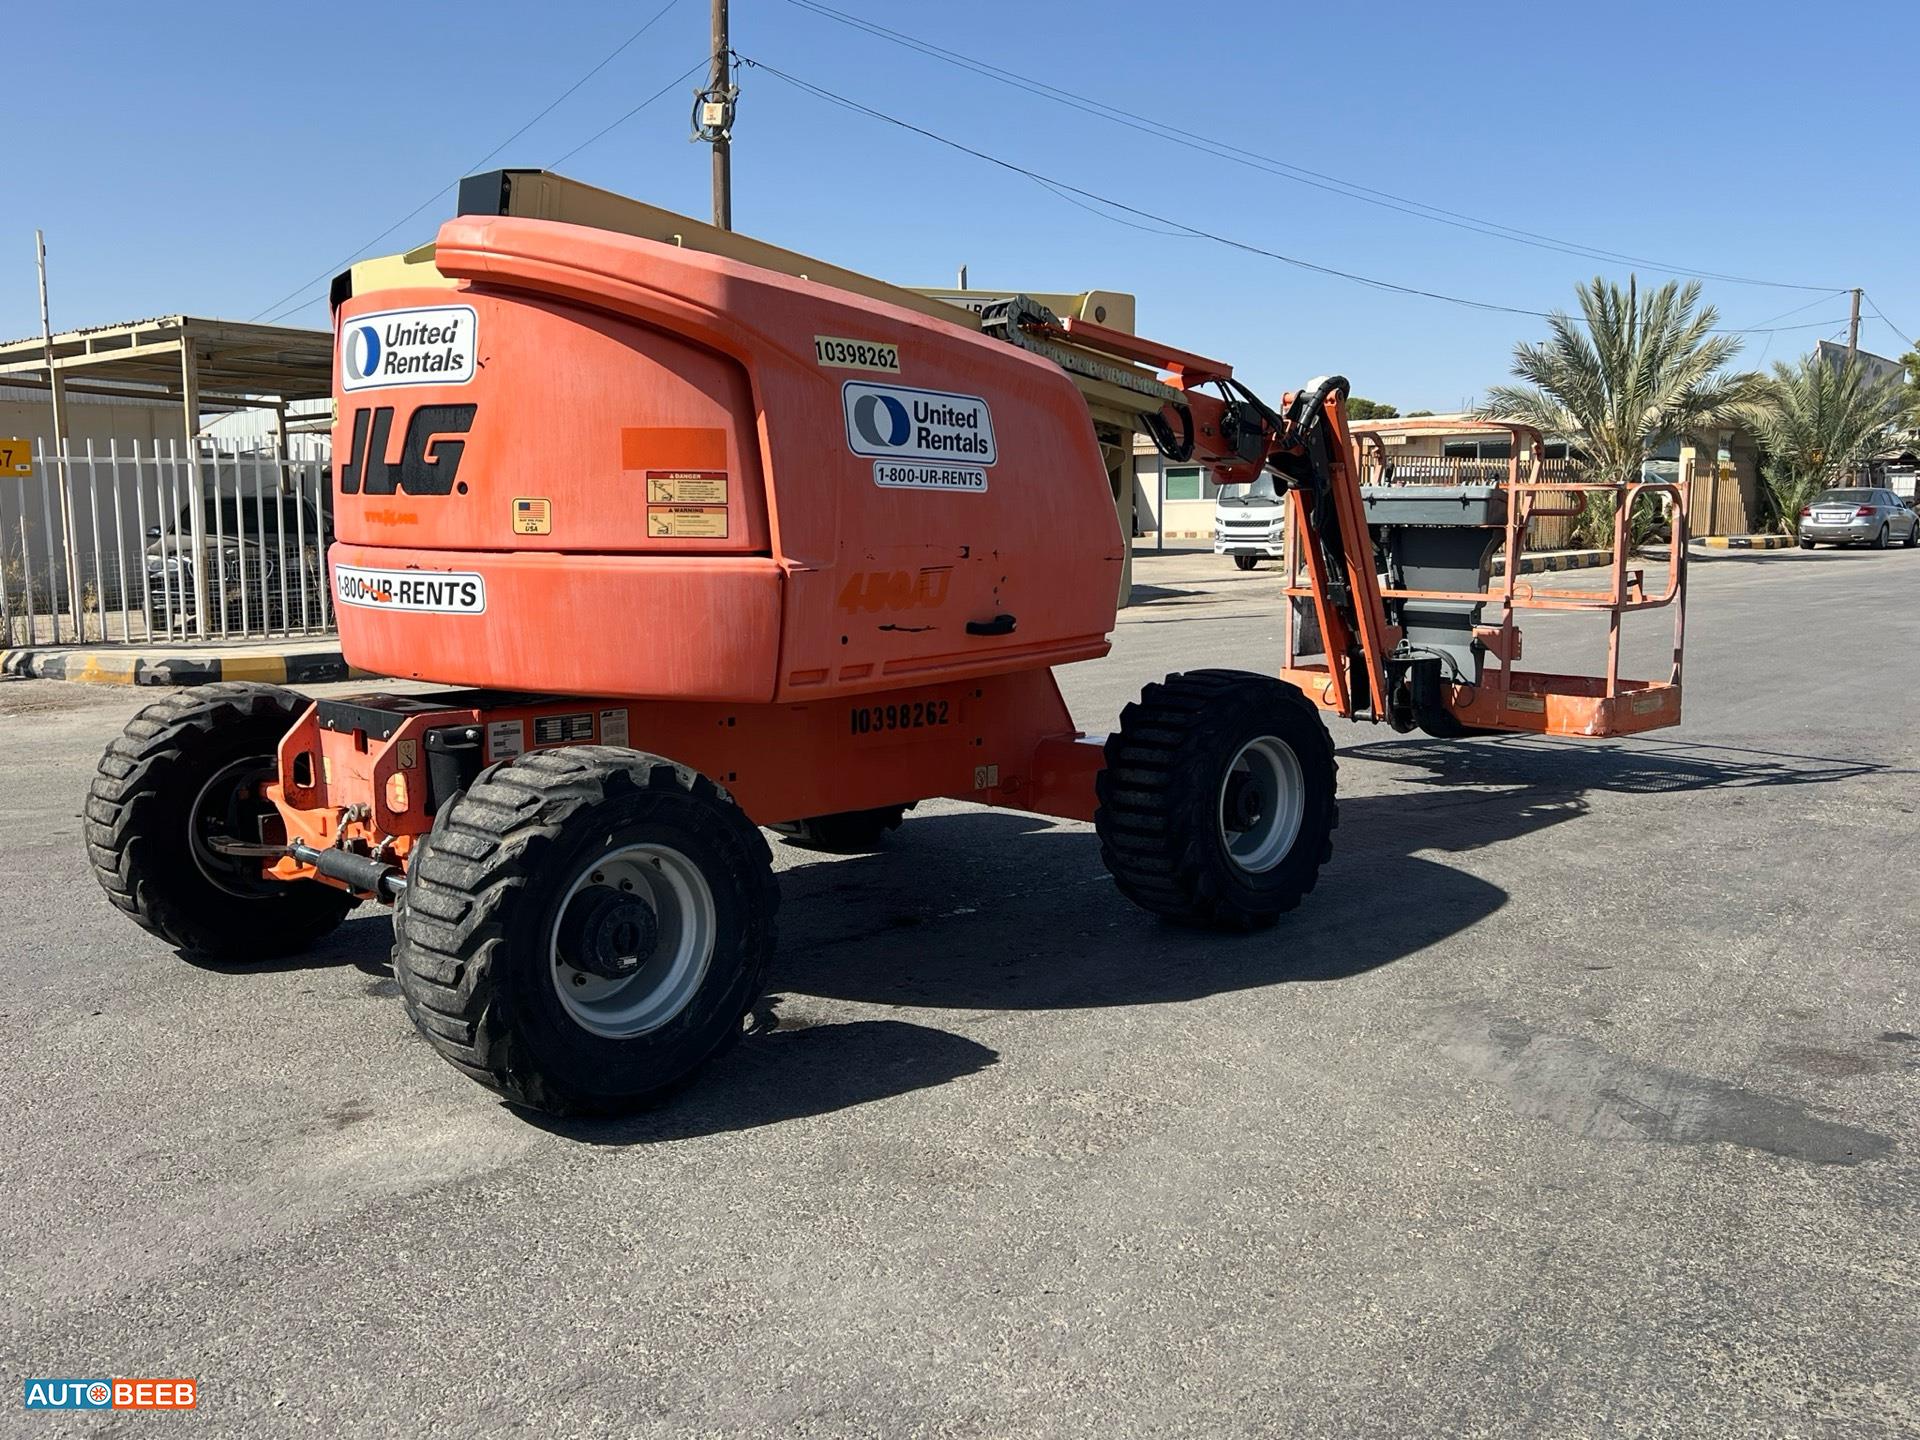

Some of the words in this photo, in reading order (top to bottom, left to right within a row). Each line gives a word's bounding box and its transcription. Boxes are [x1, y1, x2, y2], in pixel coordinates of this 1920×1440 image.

[384, 319, 459, 348] United
[383, 347, 465, 376] Rentals
[814, 339, 899, 369] 10398262
[912, 400, 979, 429] United
[916, 426, 989, 455] Rentals
[0, 449, 13, 468] 7
[877, 466, 983, 487] 1-800-UR-RENTS
[337, 574, 477, 607] 1-800-UR-RENTS
[851, 701, 949, 735] 10398262
